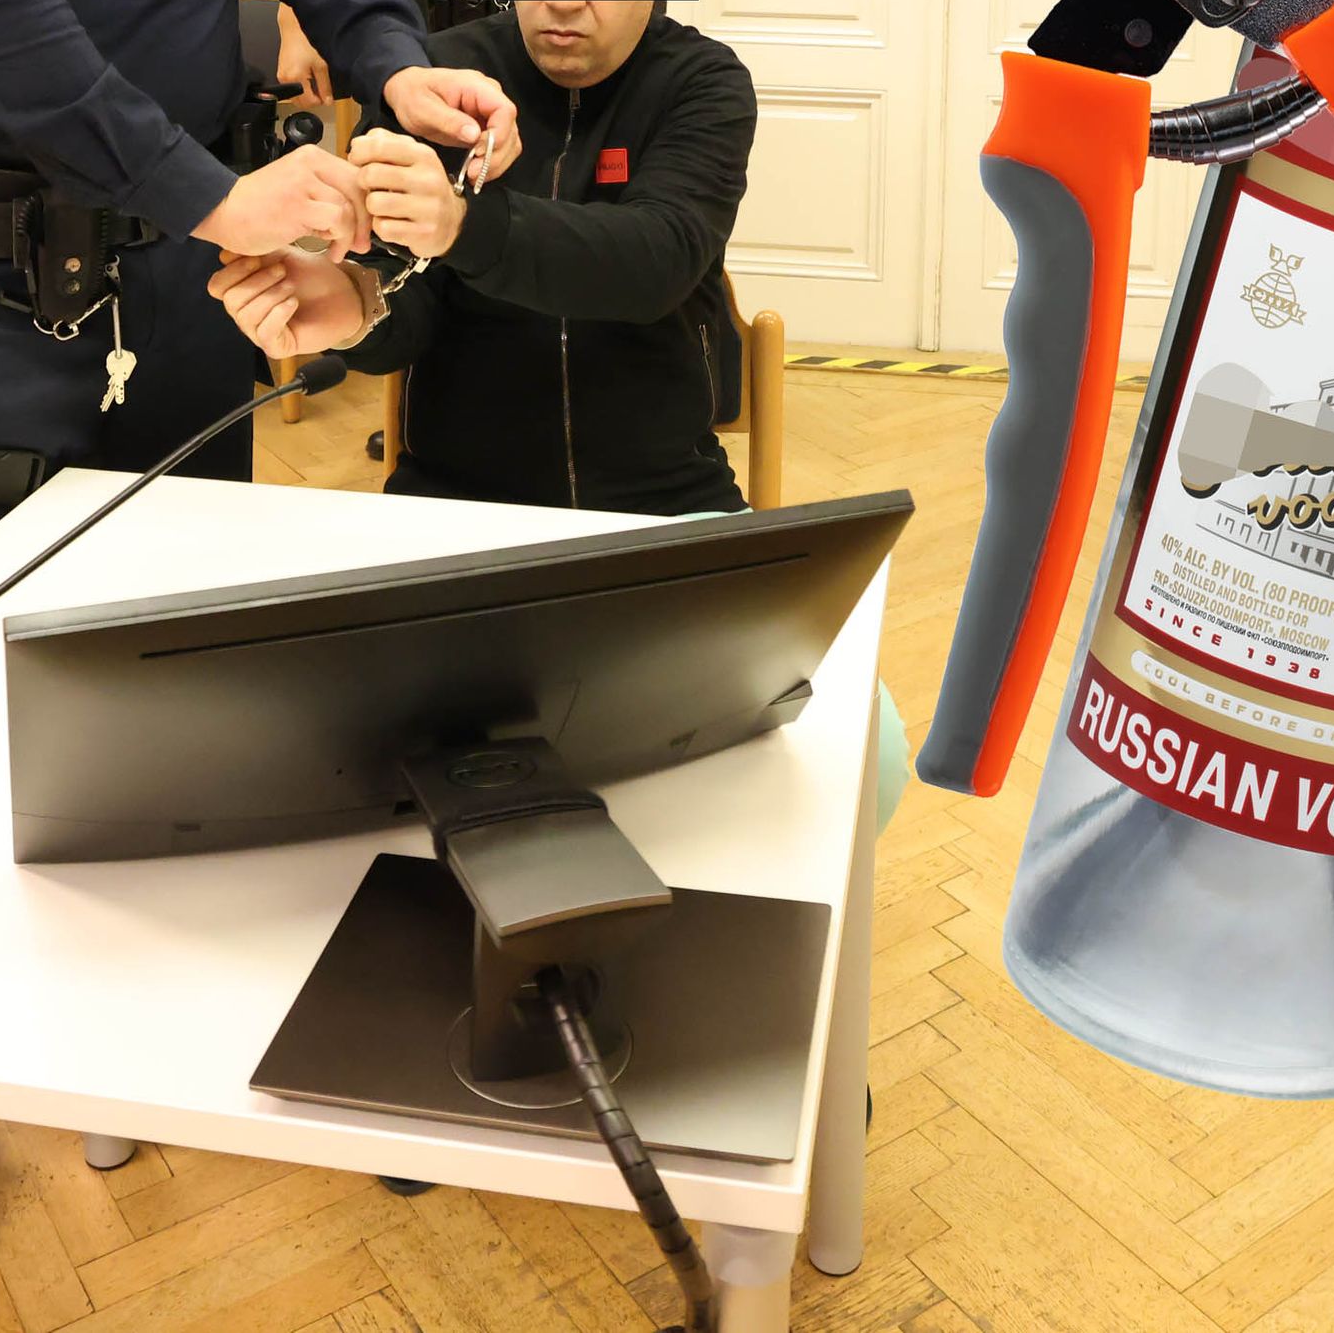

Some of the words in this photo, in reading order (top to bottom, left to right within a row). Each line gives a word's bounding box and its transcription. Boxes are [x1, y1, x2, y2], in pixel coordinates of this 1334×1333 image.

[1161, 533, 1183, 558] 40%
[1184, 547, 1208, 572] ALC.
[1211, 560, 1231, 580] BY
[1232, 569, 1260, 594] VOL.
[1262, 580, 1287, 603] (80
[1172, 561, 1216, 594] DISTILLED
[1217, 585, 1237, 603] AND
[1238, 593, 1285, 621] BOTTLED
[1285, 611, 1309, 628] FOR
[1144, 598, 1223, 646] SINCE
[1247, 647, 1321, 680] 1938
[1153, 569, 1168, 588] FKP
[1279, 626, 1330, 652] MOSCOW
[1185, 603, 1207, 621] РАЗЛИТО
[1207, 613, 1216, 625] ПО
[1216, 617, 1247, 637] ЛИЦЕНЗИИ
[1246, 630, 1261, 641] ФКП
[1143, 661, 1191, 694] COOL
[1205, 692, 1299, 732] BEFORE
[1078, 678, 1279, 822] RUSSIAN
